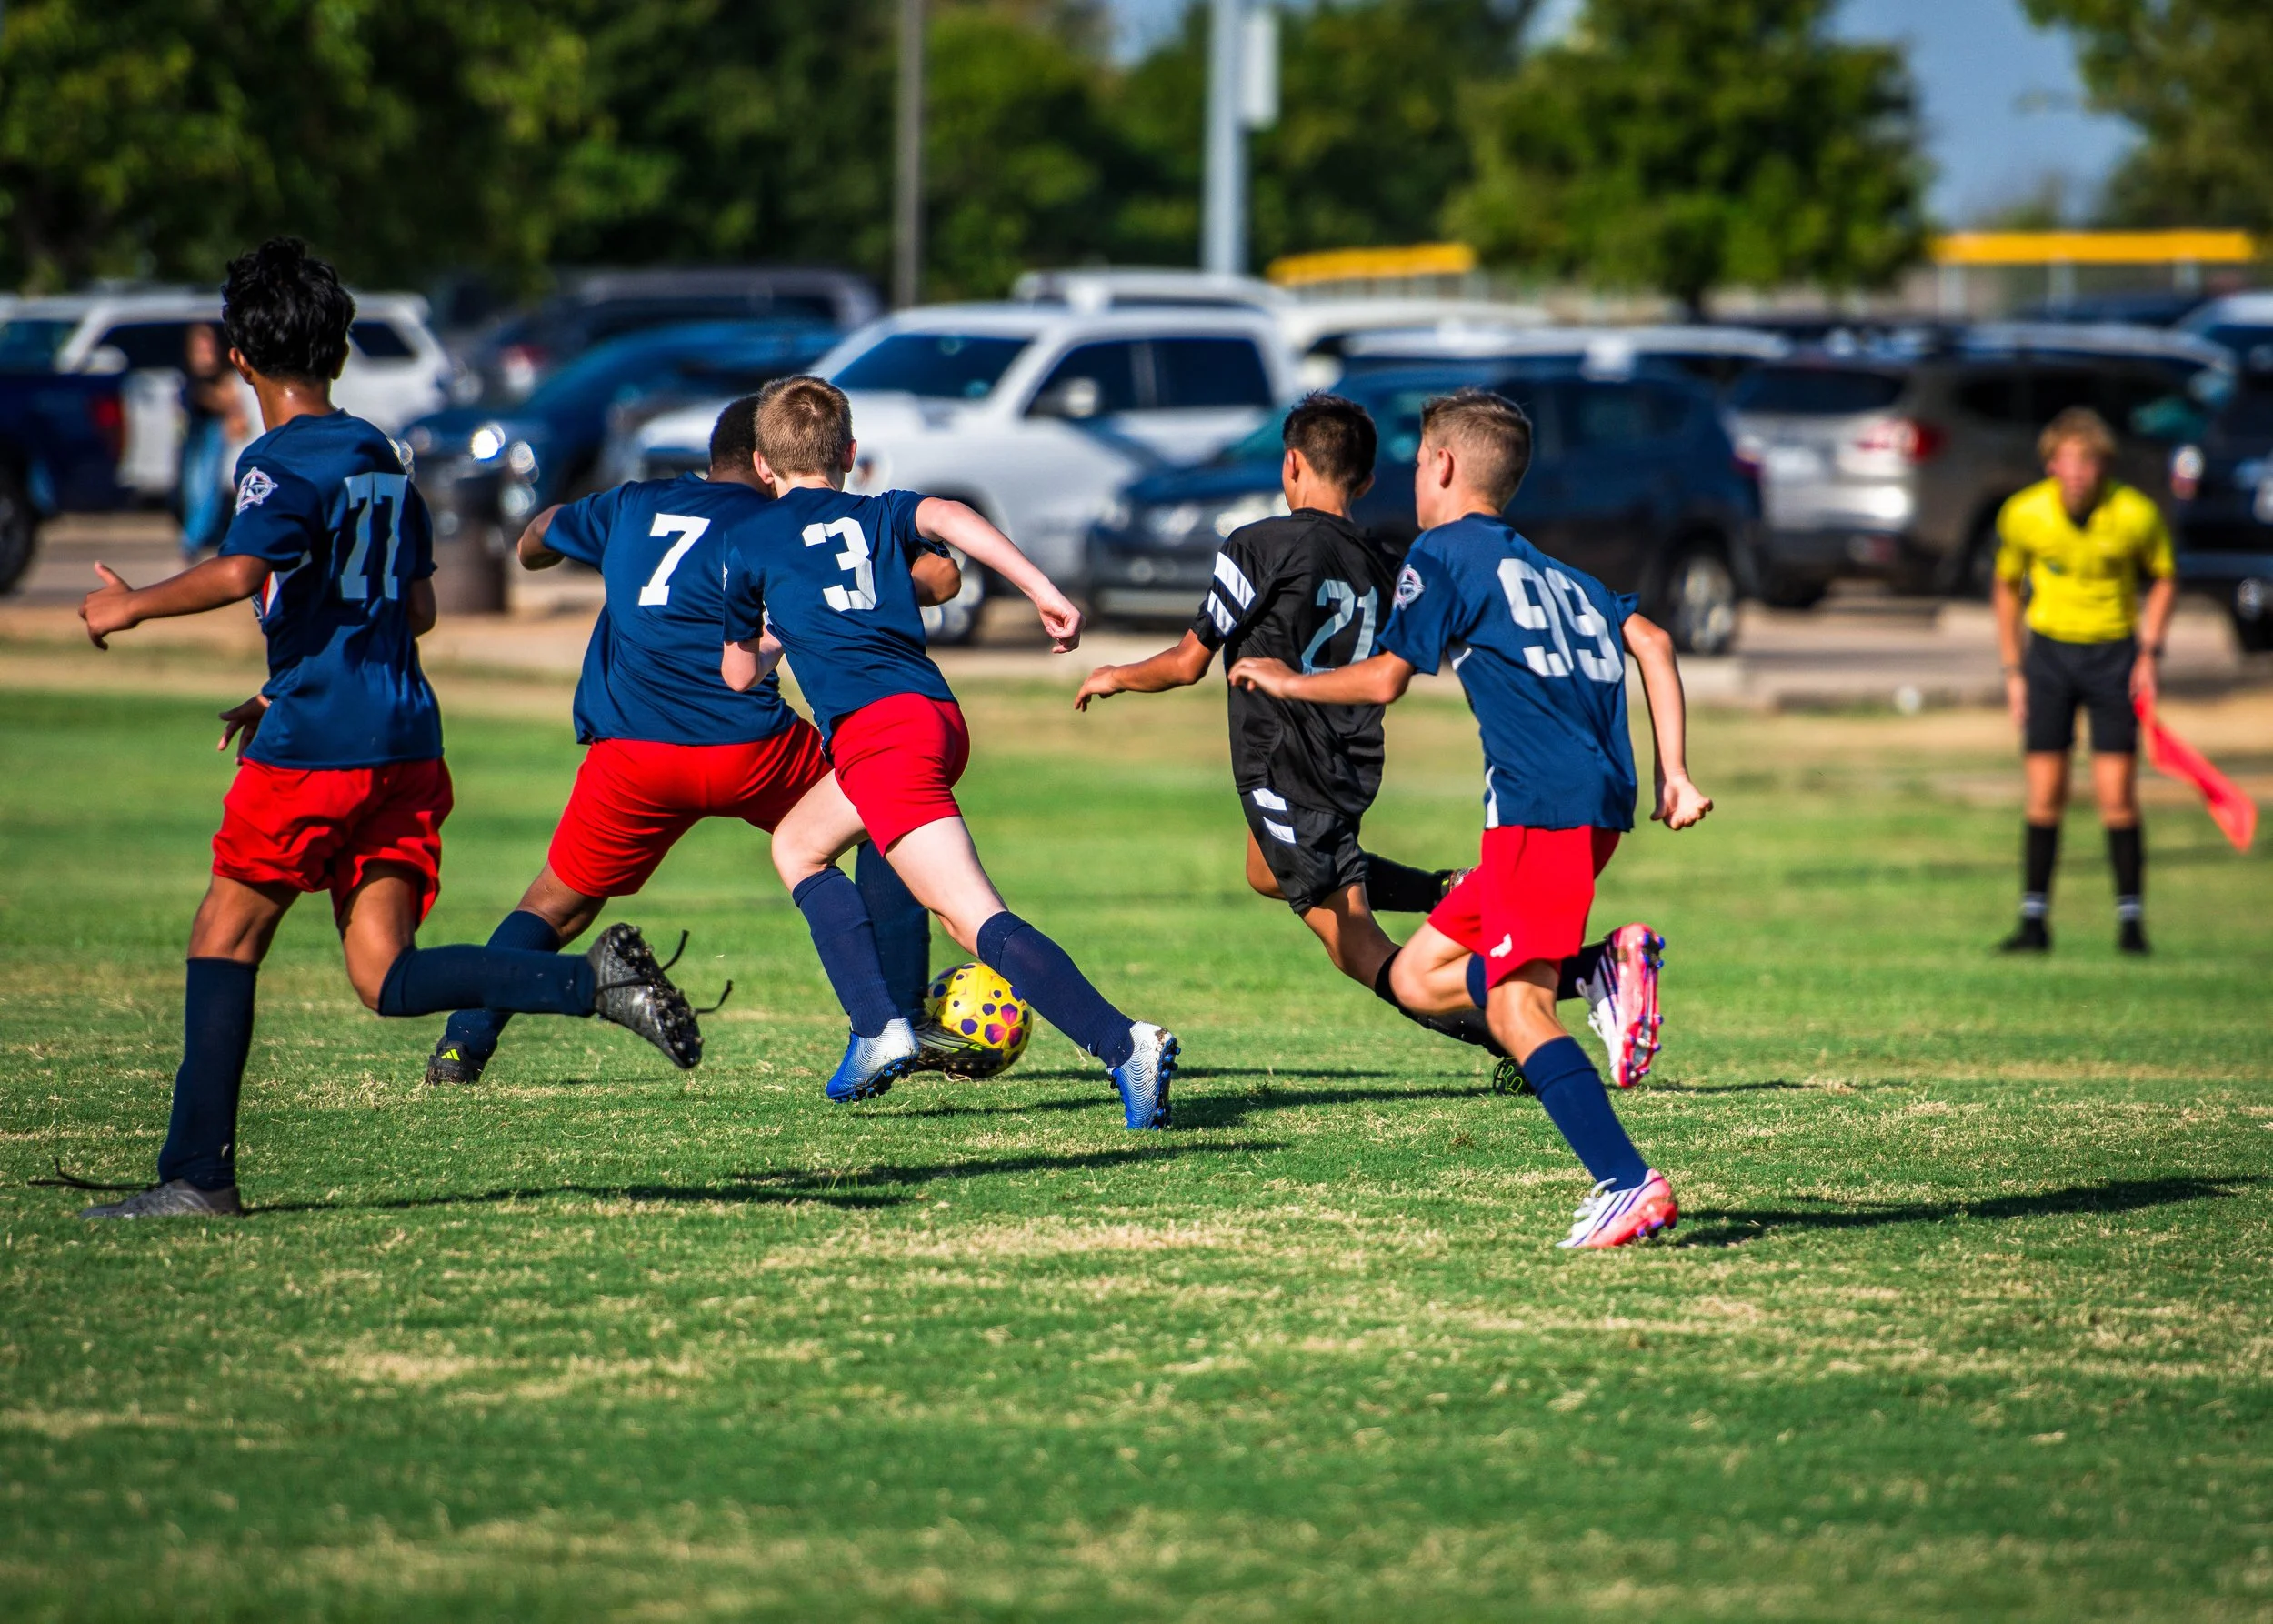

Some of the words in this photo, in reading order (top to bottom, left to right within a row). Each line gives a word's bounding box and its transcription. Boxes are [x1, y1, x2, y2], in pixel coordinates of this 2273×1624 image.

[340, 471, 407, 600] 77
[638, 513, 711, 606] 7
[802, 516, 877, 612] 3
[1301, 579, 1378, 674] 21
[1497, 558, 1624, 682] 99
